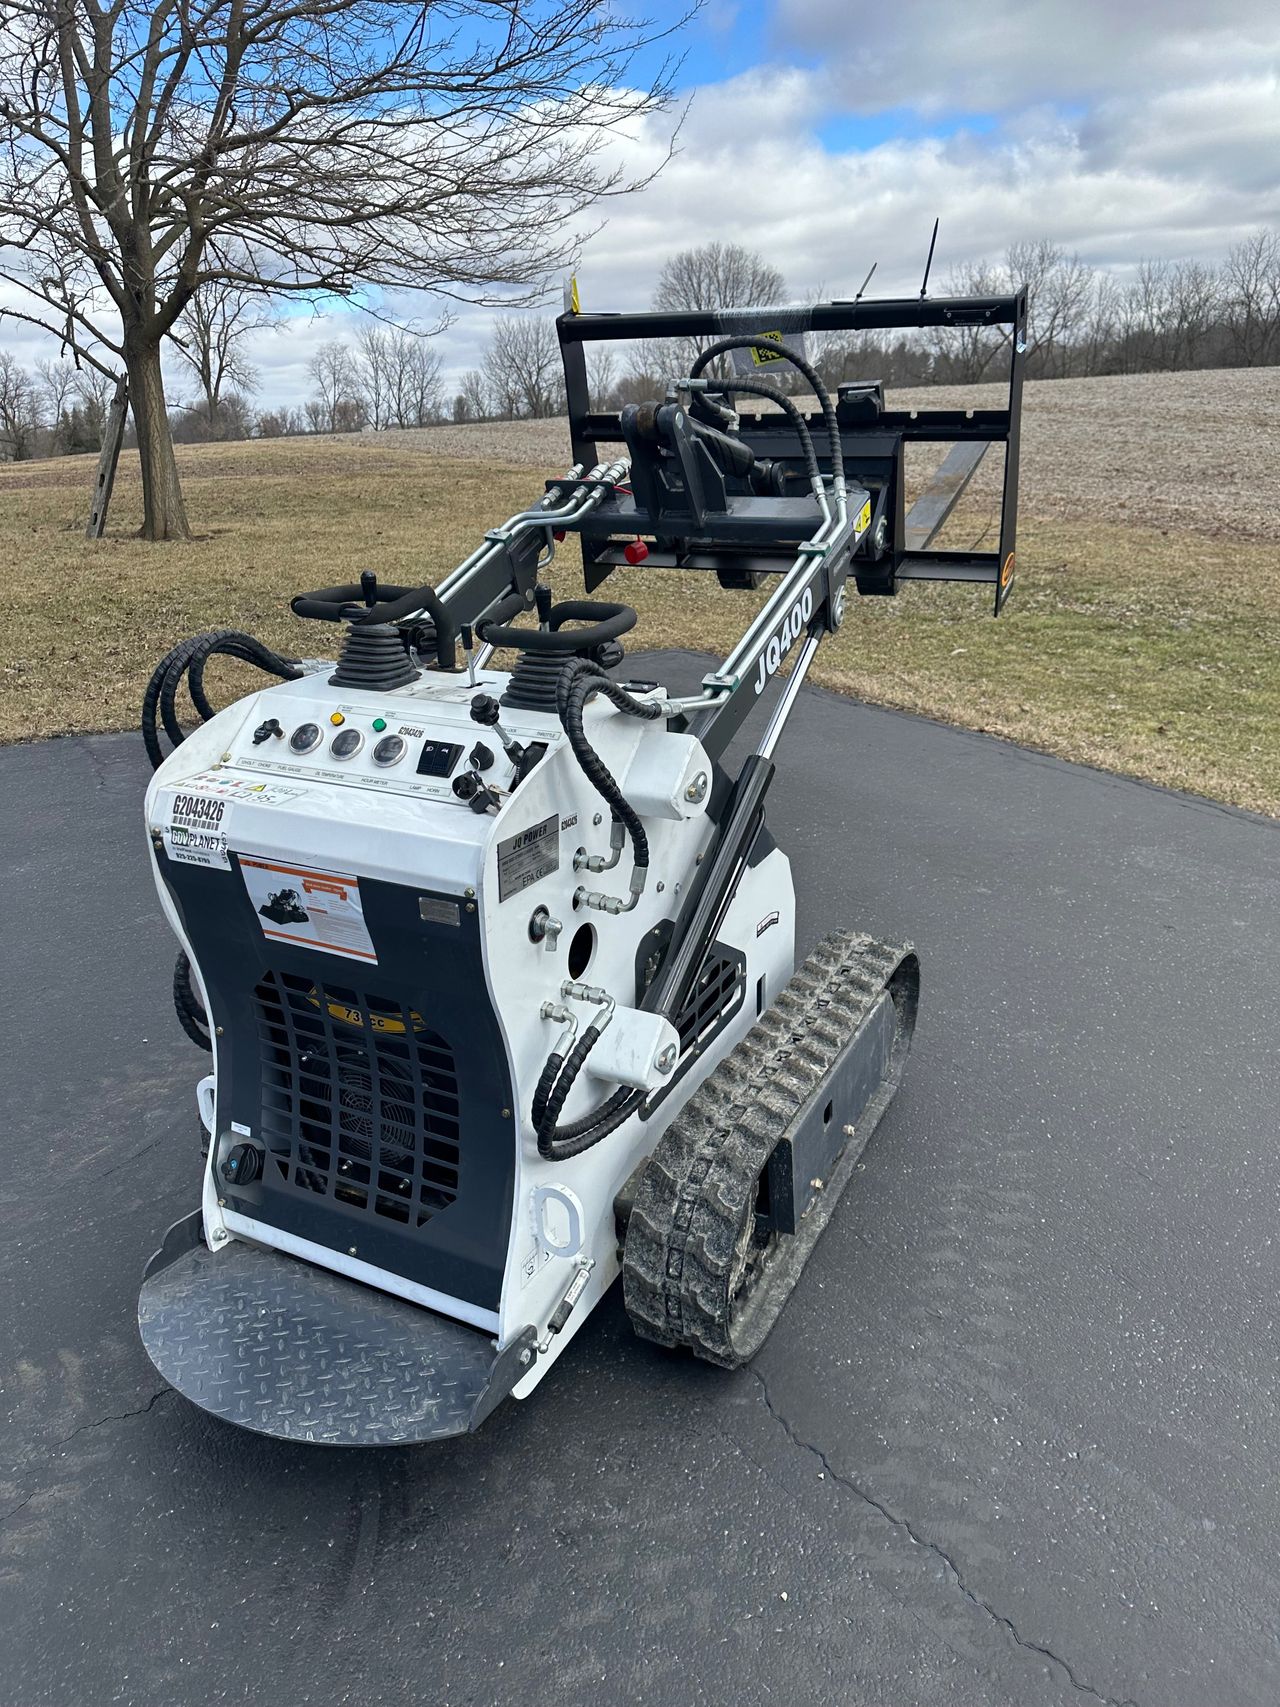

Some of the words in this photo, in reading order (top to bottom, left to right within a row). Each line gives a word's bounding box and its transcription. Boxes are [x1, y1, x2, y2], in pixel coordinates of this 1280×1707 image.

[755, 587, 813, 695] JQ400
[398, 726, 425, 738] G2043426
[172, 795, 225, 821] G2043426
[171, 829, 220, 851] GOVPLANET
[523, 824, 548, 845] POWER
[522, 873, 535, 887] EPA
[535, 868, 543, 879] CE
